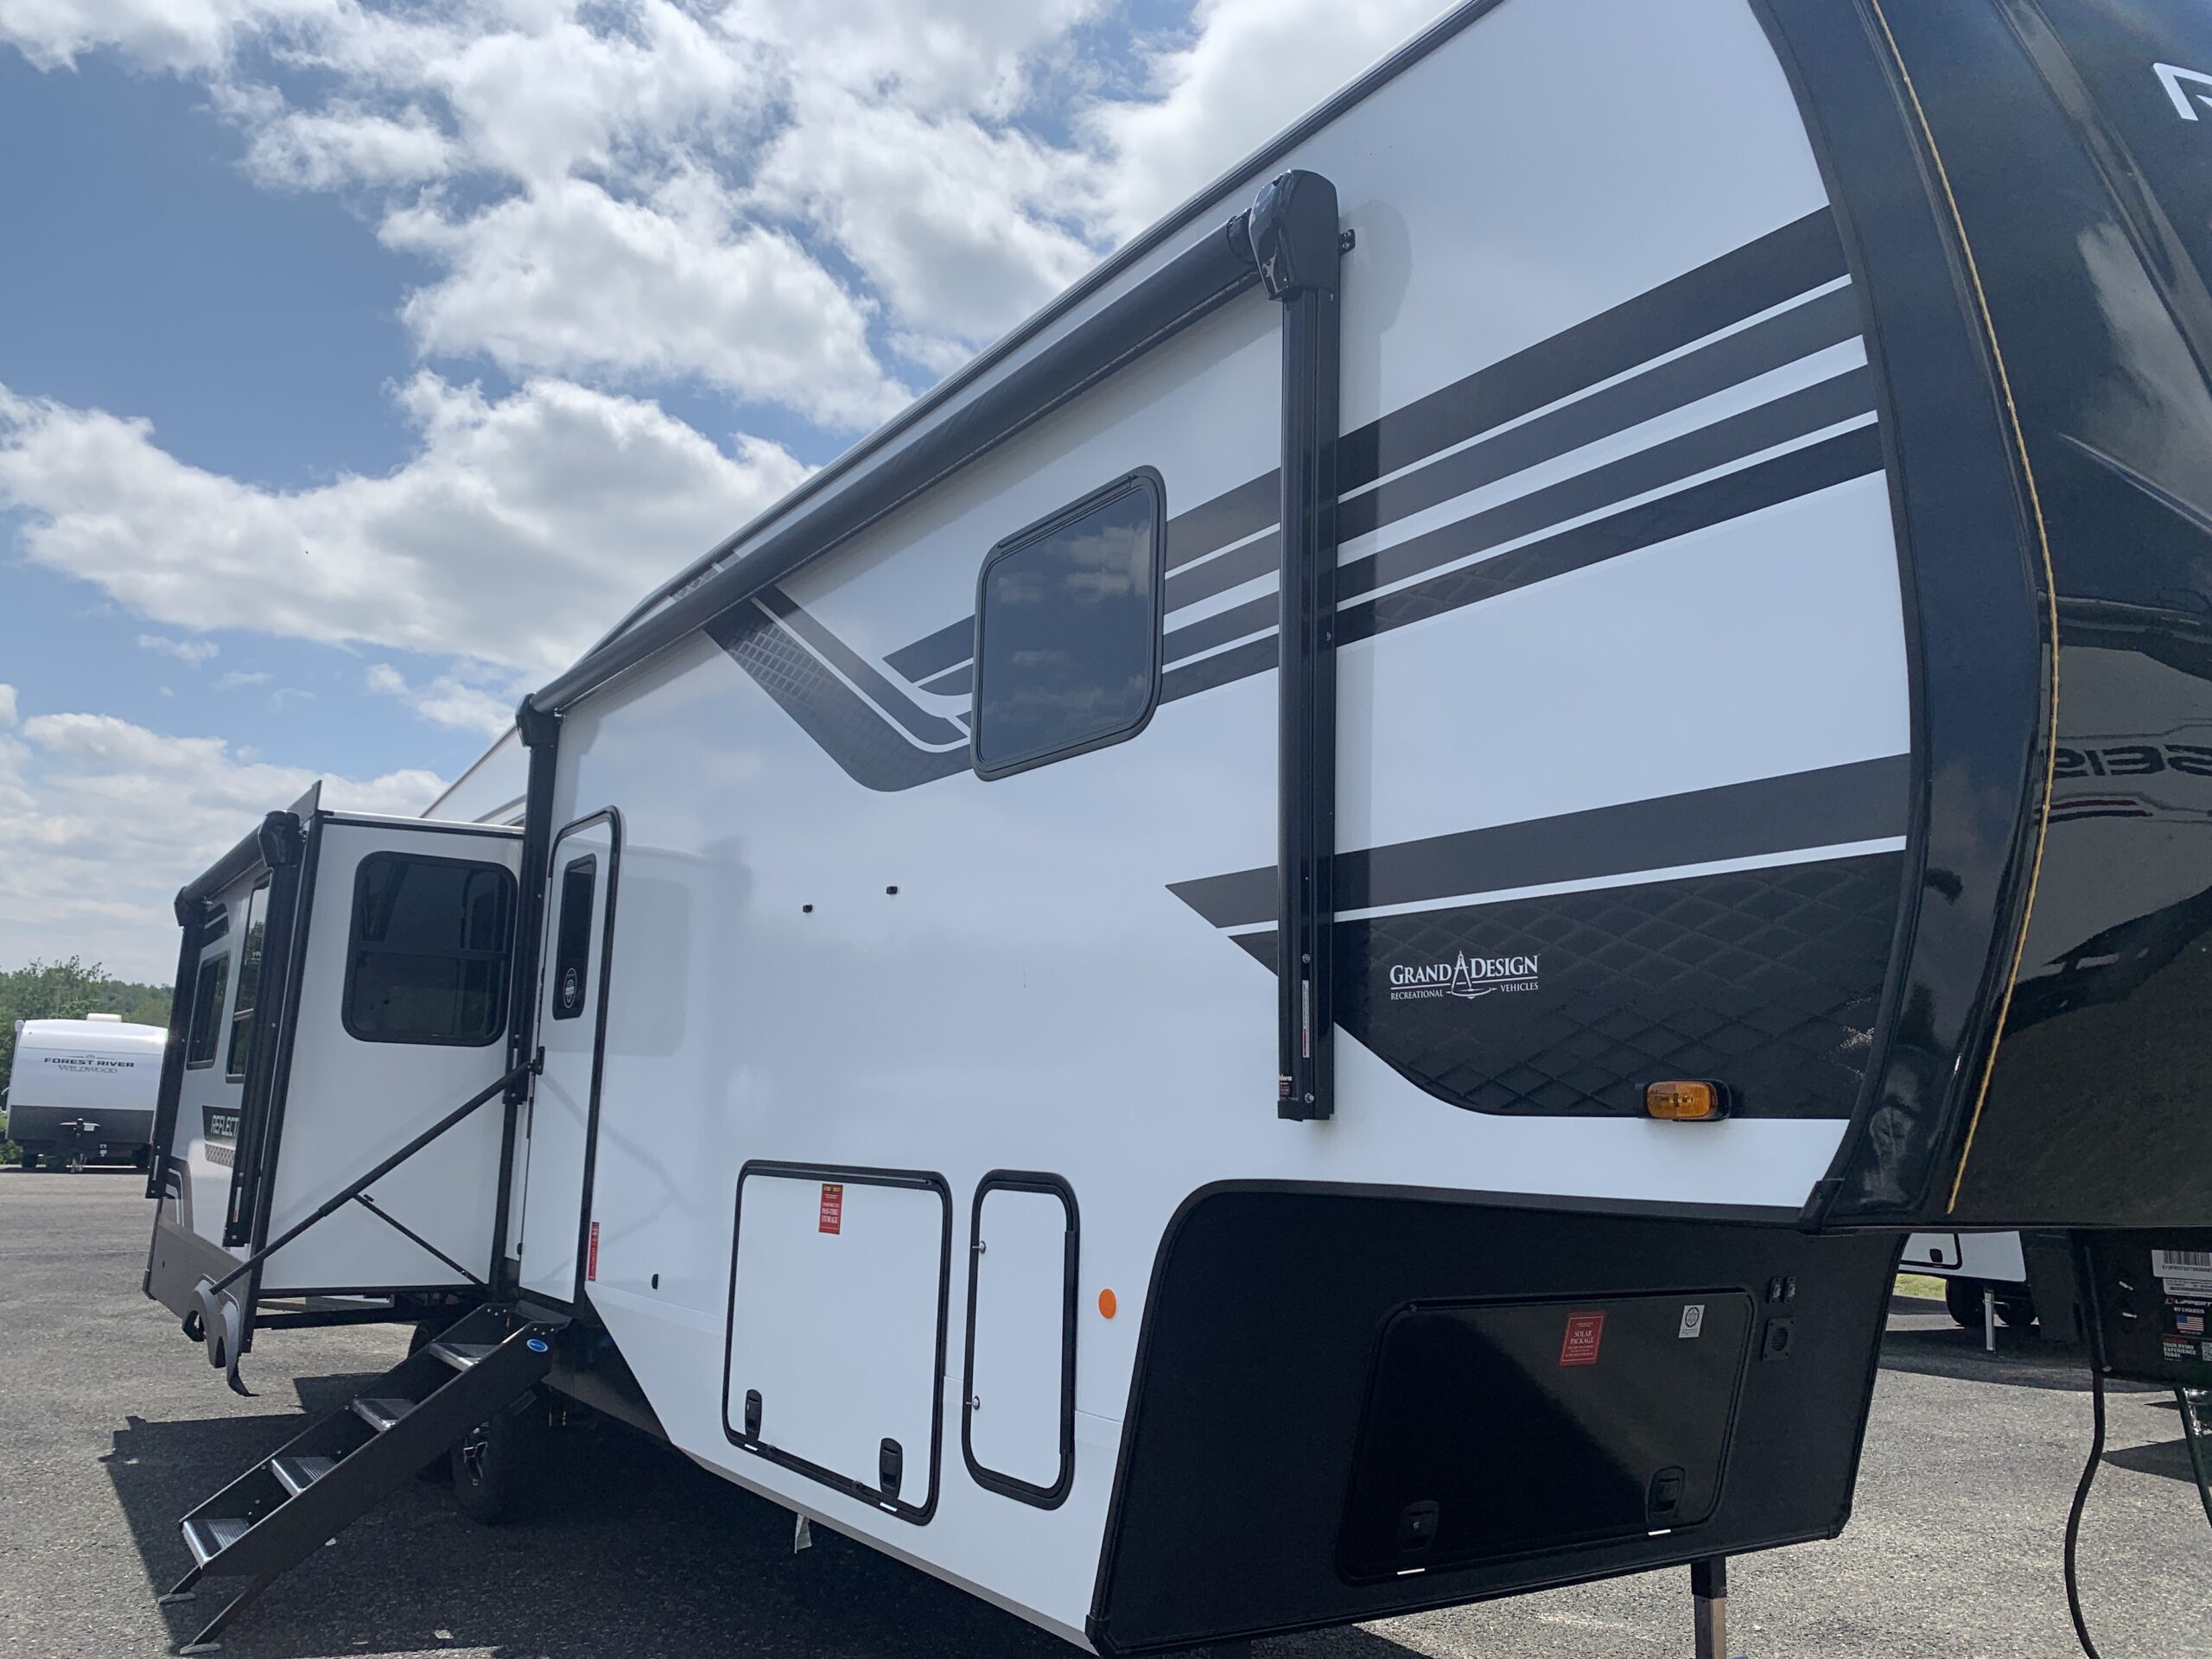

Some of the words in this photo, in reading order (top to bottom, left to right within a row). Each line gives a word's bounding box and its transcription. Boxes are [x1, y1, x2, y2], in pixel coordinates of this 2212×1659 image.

[1389, 963, 1452, 985] GRAND
[1470, 955, 1539, 979] DESIGN
[1390, 988, 1444, 1001] RECREATIONAL
[1500, 982, 1539, 993] VEHICLES
